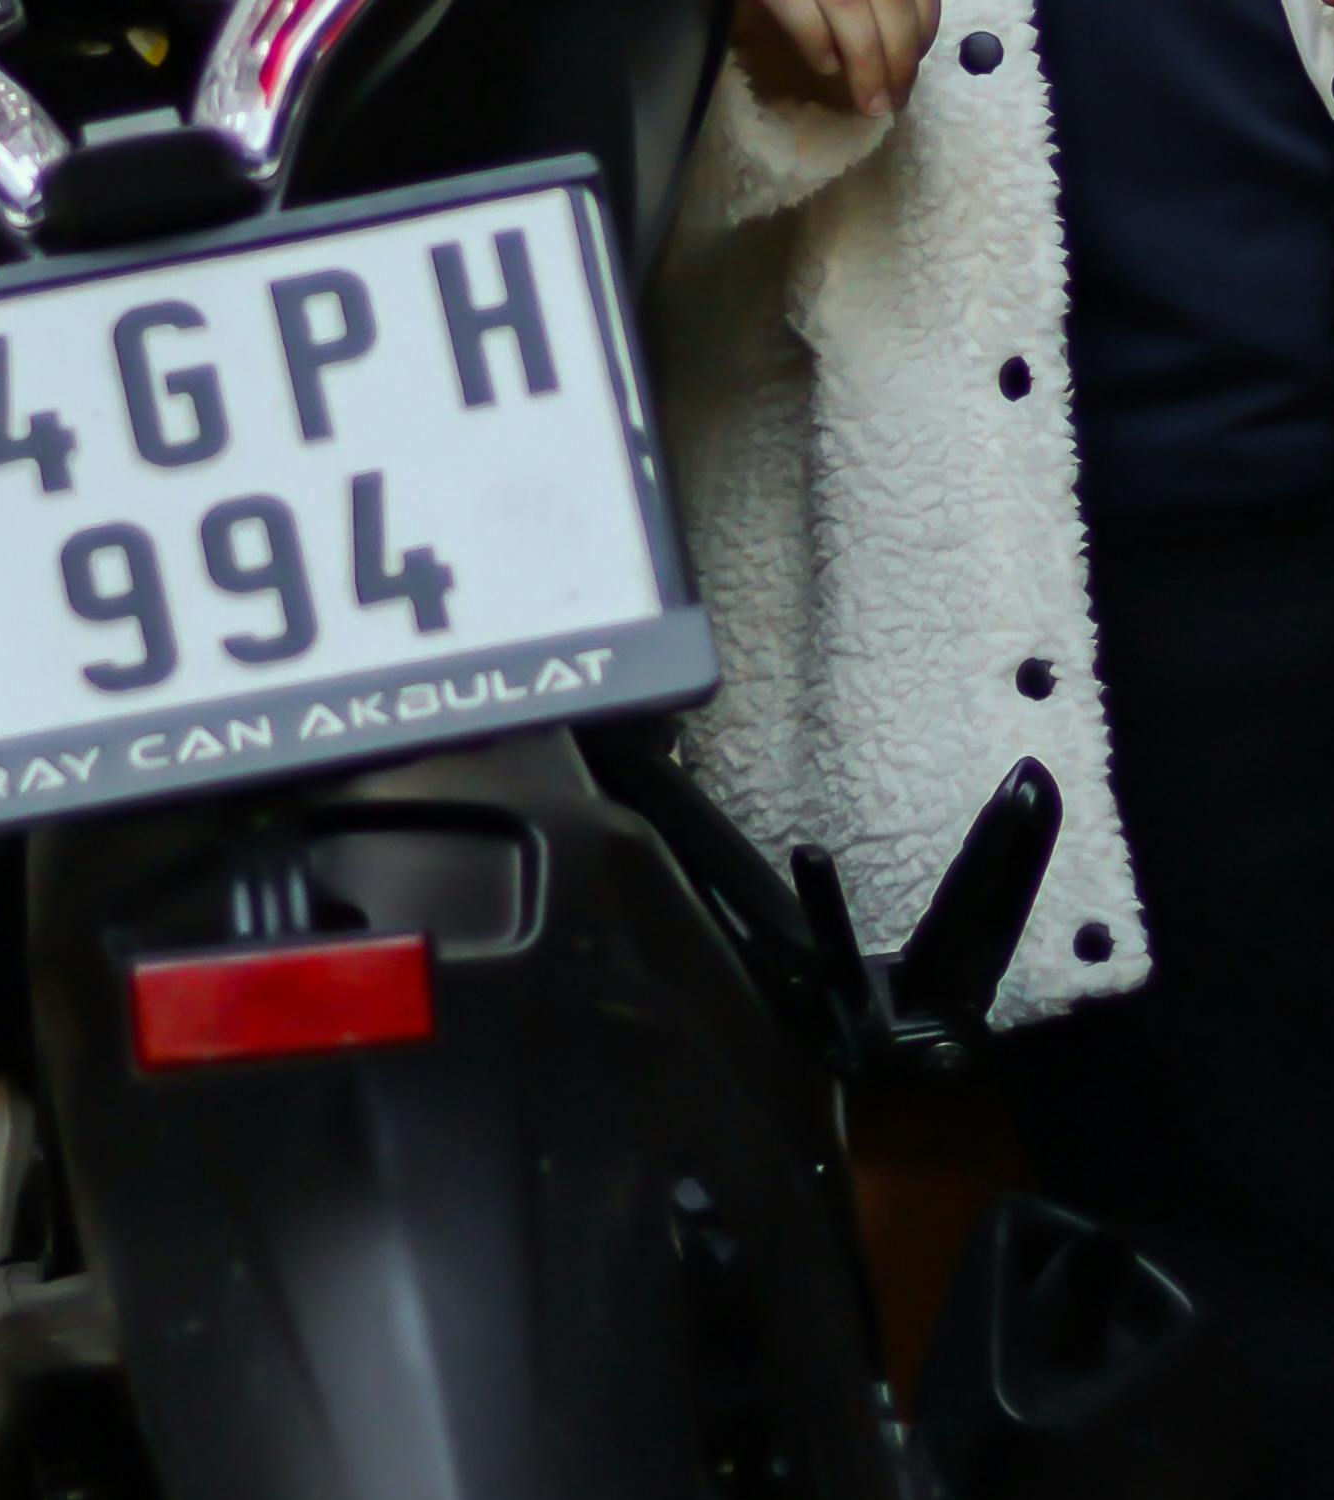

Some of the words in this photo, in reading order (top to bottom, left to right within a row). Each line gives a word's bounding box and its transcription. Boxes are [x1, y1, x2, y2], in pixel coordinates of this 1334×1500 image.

[59, 471, 453, 694] 994
[128, 714, 273, 771] CAN
[299, 646, 614, 743] AKBULAT
